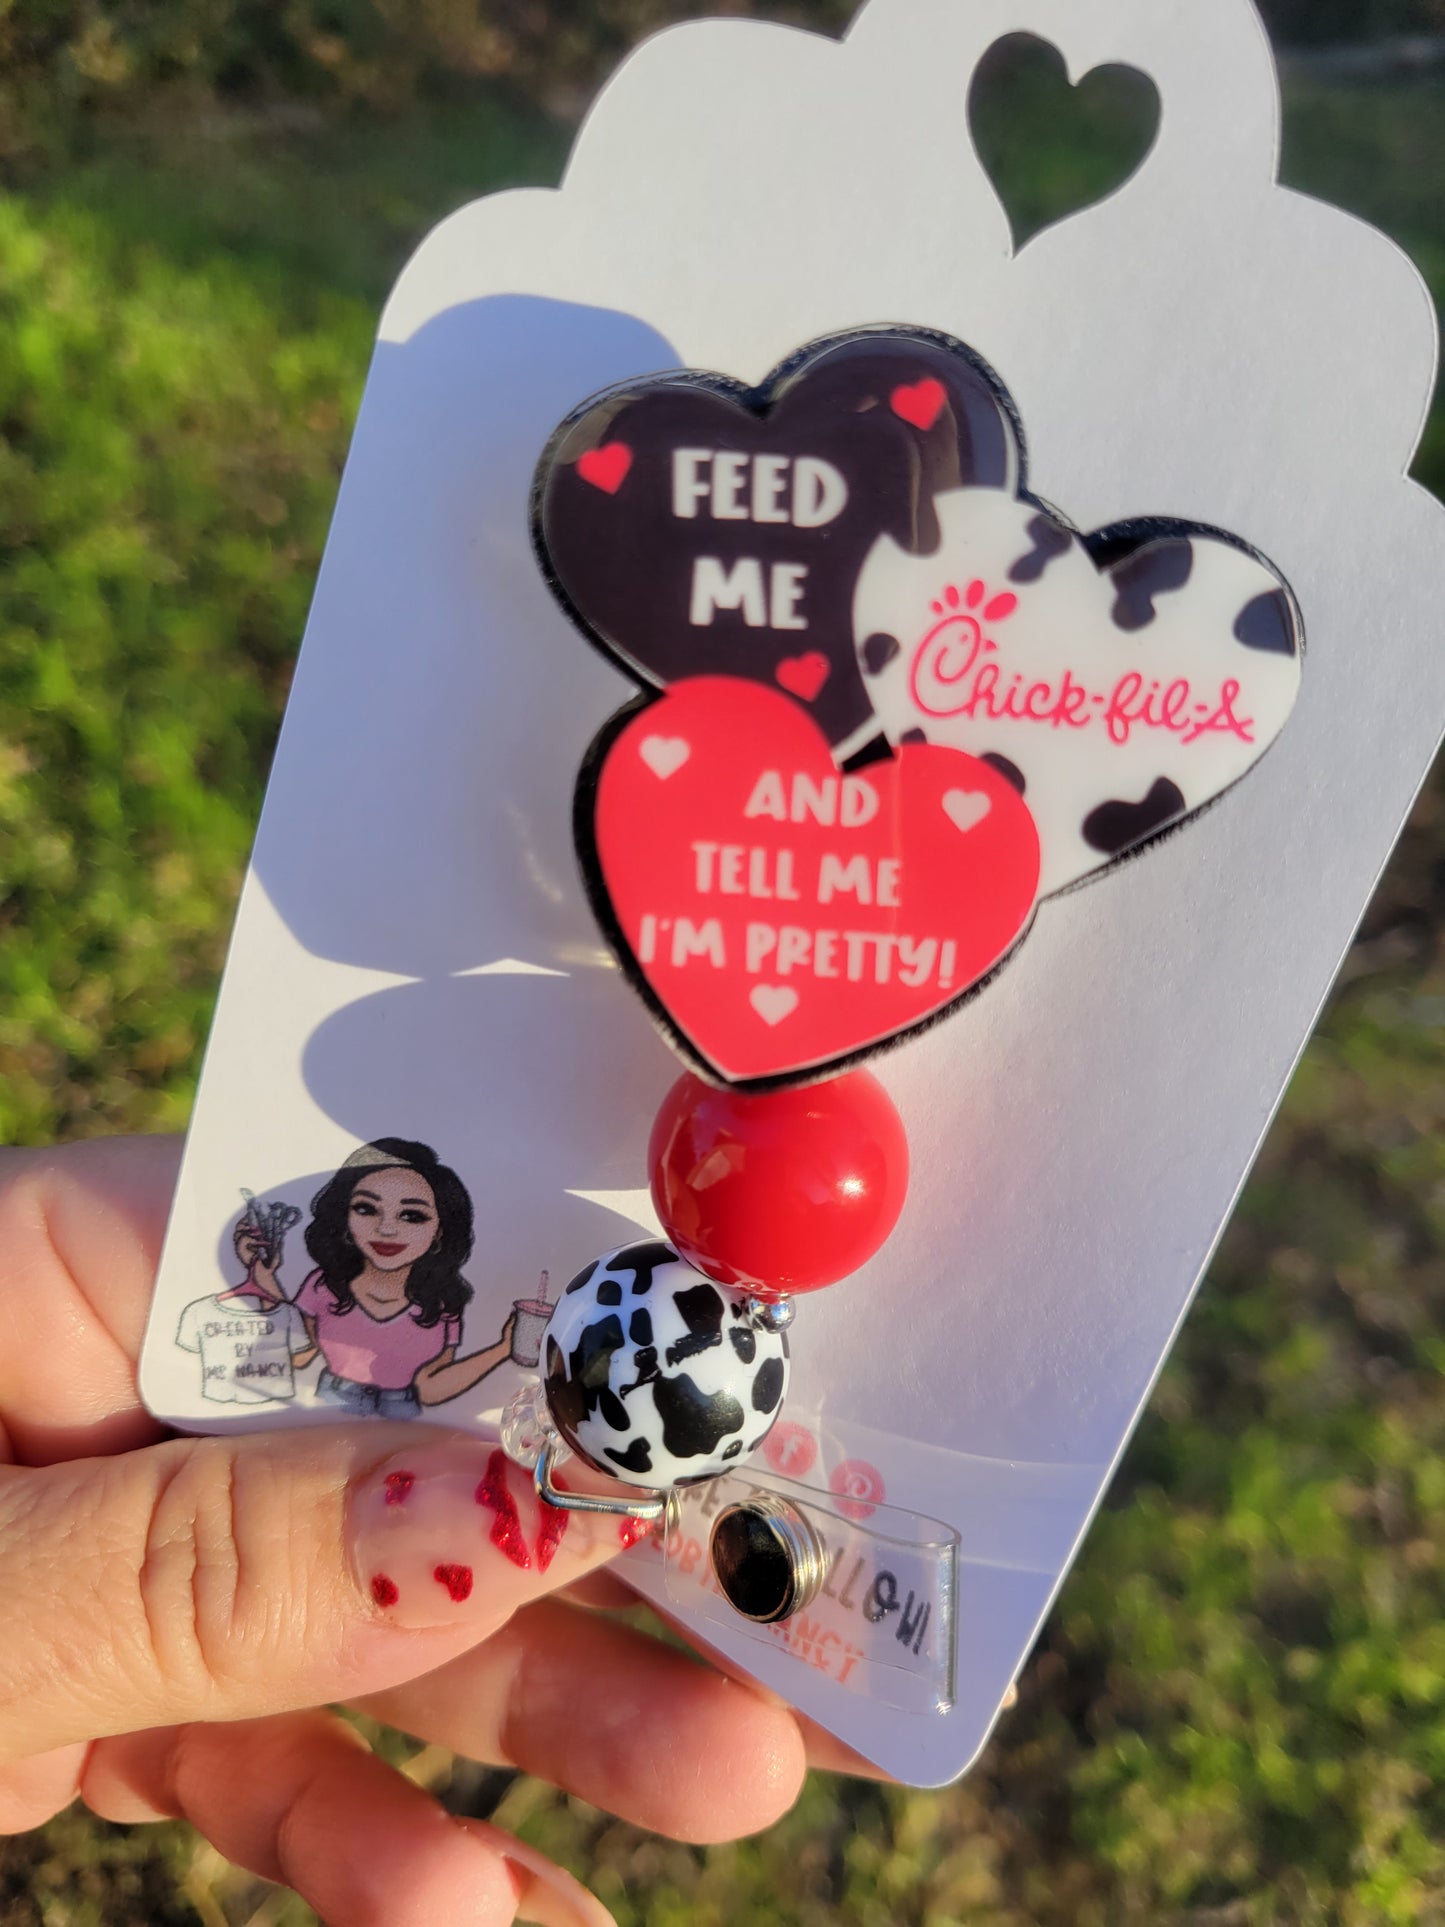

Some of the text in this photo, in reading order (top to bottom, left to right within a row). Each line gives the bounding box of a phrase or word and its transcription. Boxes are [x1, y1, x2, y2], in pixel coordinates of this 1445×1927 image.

[672, 447, 849, 528] FEED
[689, 555, 809, 630] ME
[908, 614, 1255, 746] Chick-fil-A
[743, 769, 879, 828] AND
[690, 840, 902, 908] TELL ME
[637, 913, 957, 990] I'M PRETTY!
[203, 1320, 275, 1338] CREATED
[234, 1342, 254, 1358] BY
[235, 1362, 287, 1378] NANCY
